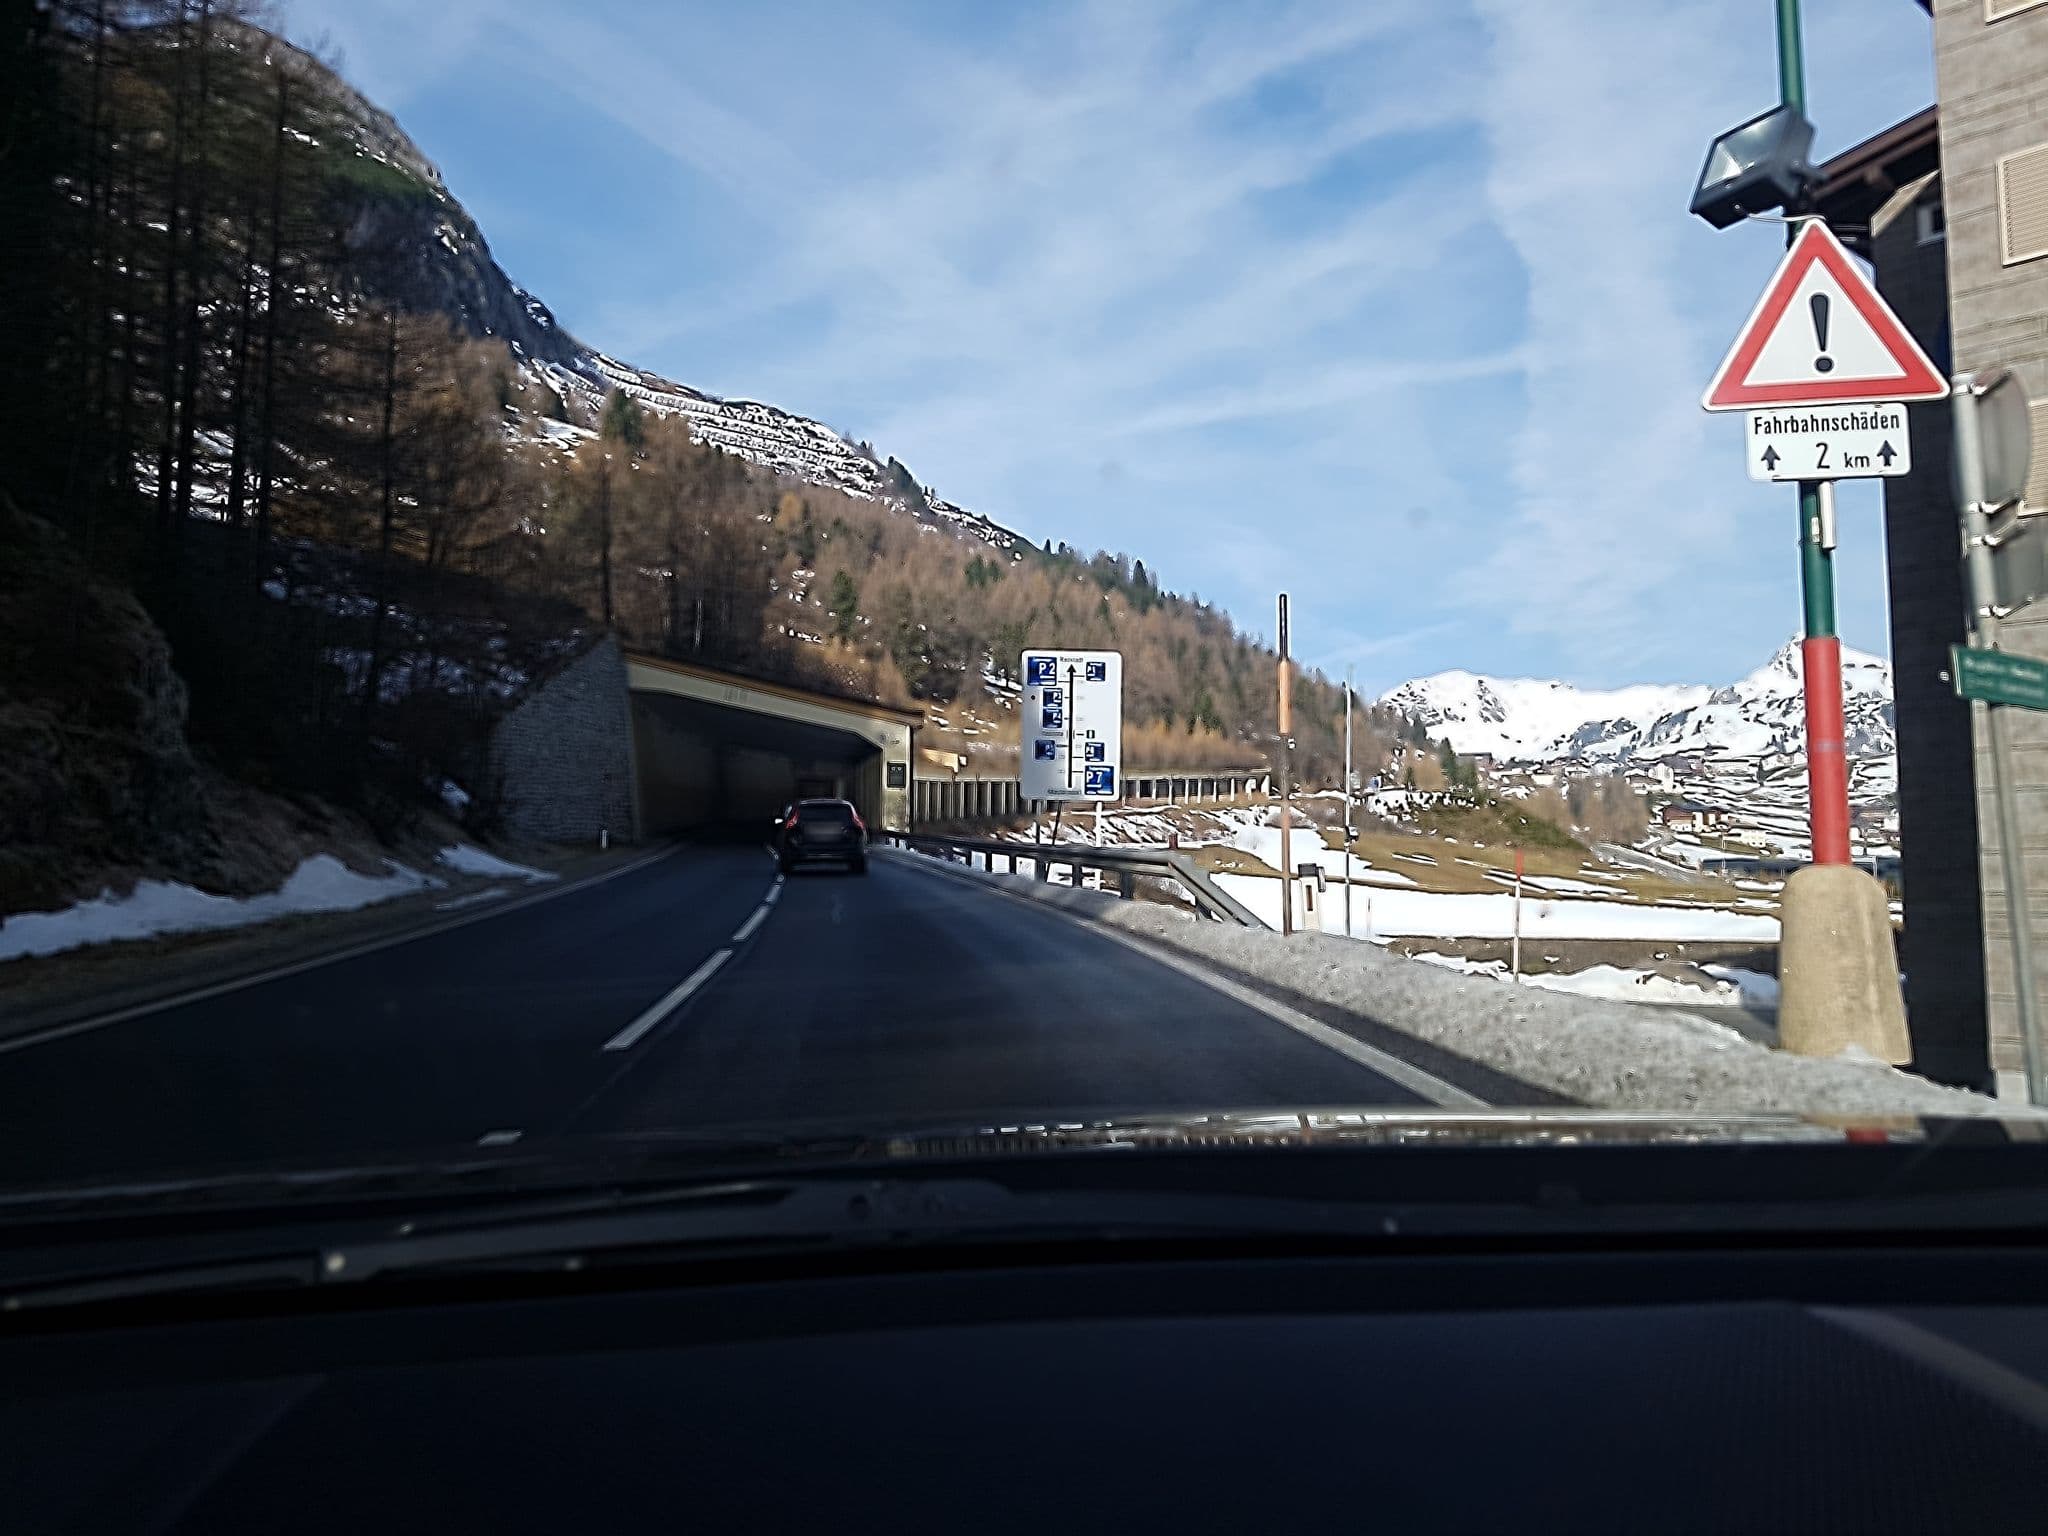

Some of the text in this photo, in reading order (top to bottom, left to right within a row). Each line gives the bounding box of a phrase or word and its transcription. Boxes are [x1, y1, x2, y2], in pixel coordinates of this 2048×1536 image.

[1754, 412, 1900, 435] Fahrbahnschäden
[1815, 442, 1870, 469] 2 km
